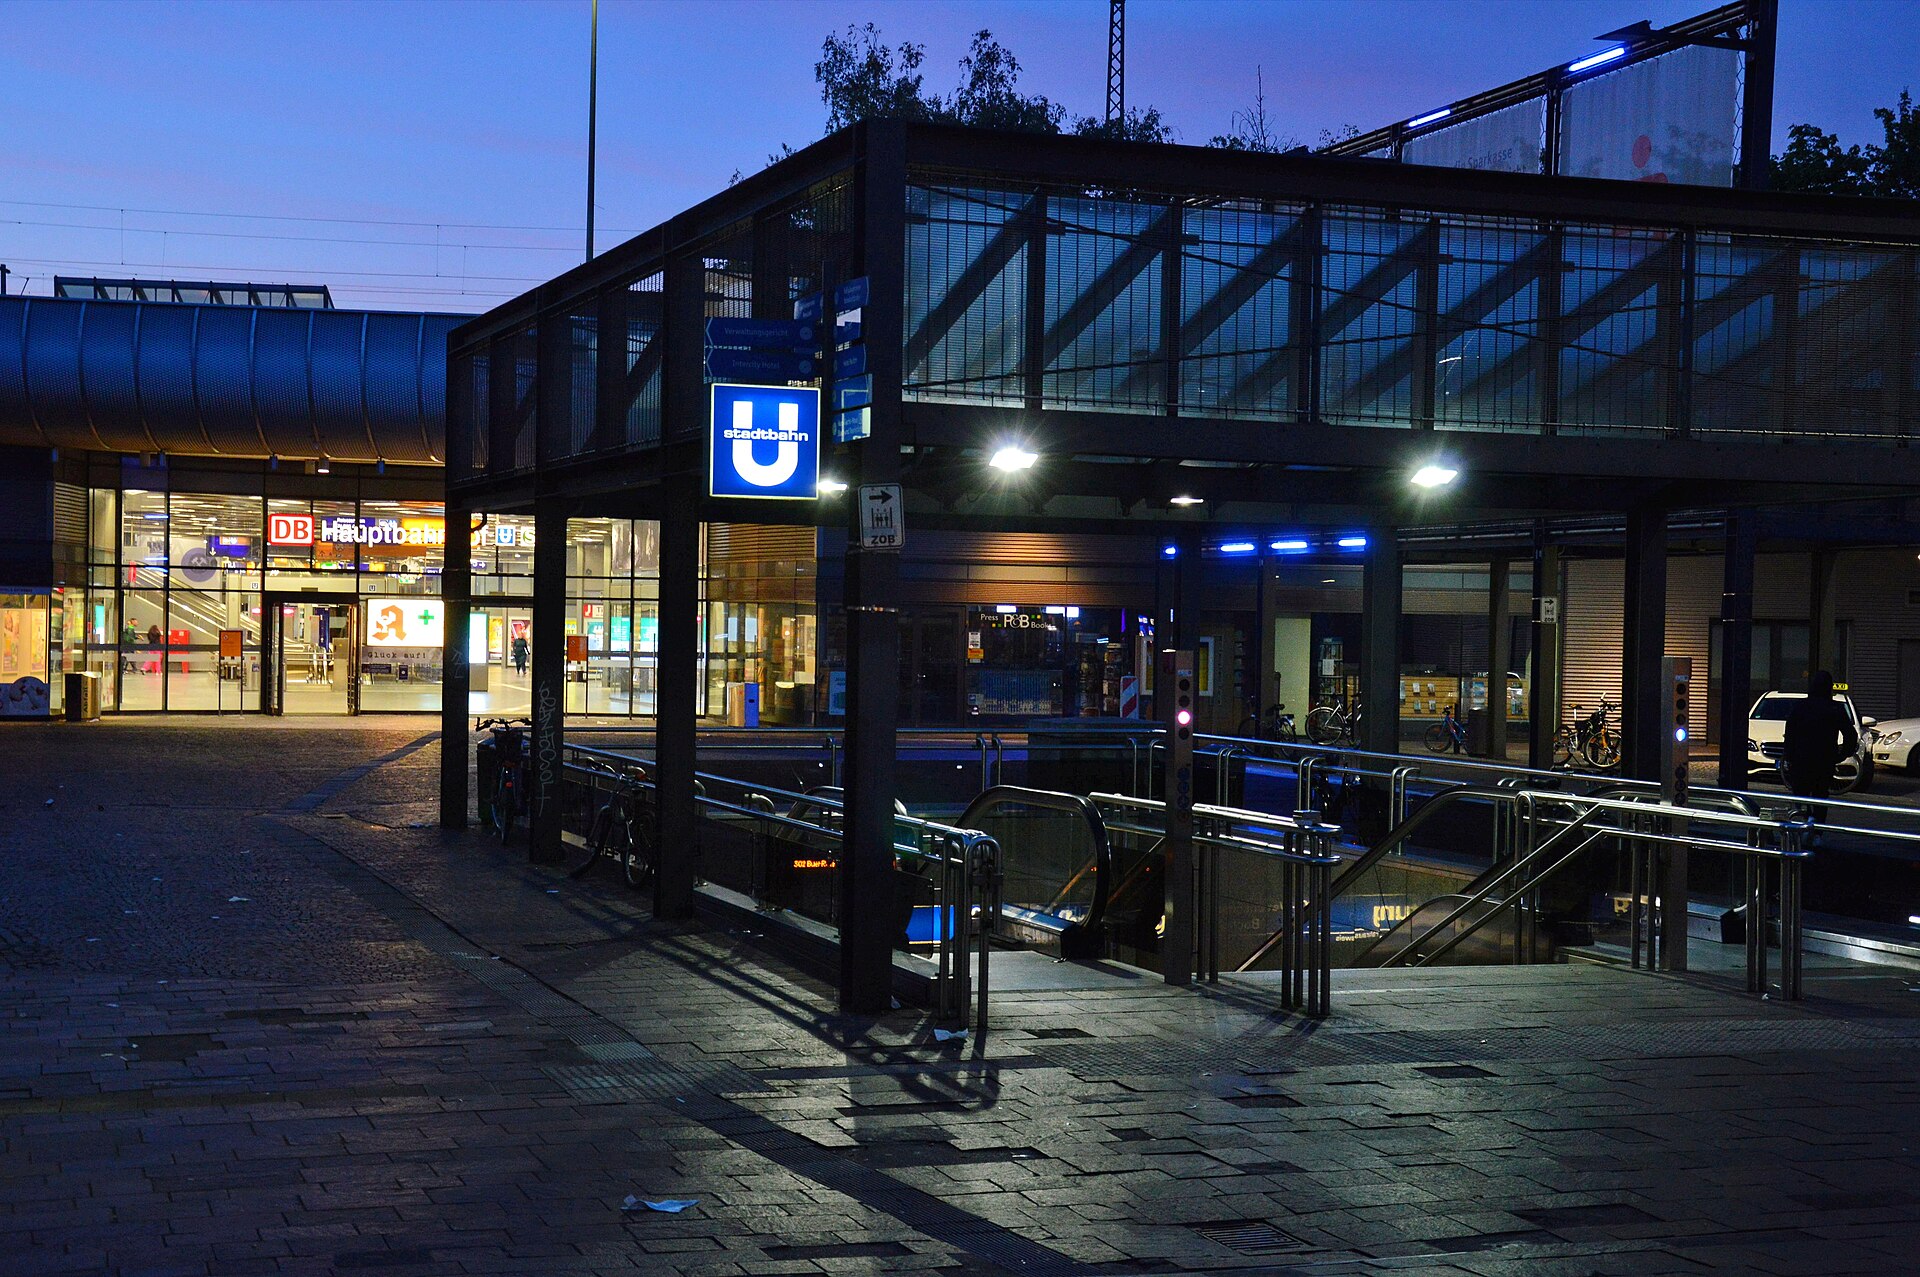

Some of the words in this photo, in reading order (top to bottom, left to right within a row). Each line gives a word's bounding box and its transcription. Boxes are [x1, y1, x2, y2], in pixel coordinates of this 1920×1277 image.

[1467, 148, 1512, 169] Sparkasse
[723, 428, 809, 442] stadtbahn
[274, 519, 309, 540] DB
[321, 518, 488, 547] Hauptbahnof
[870, 534, 896, 546] ZOB
[1003, 614, 1030, 629] P&B
[367, 651, 397, 659] Glück
[404, 651, 426, 659] auf!
